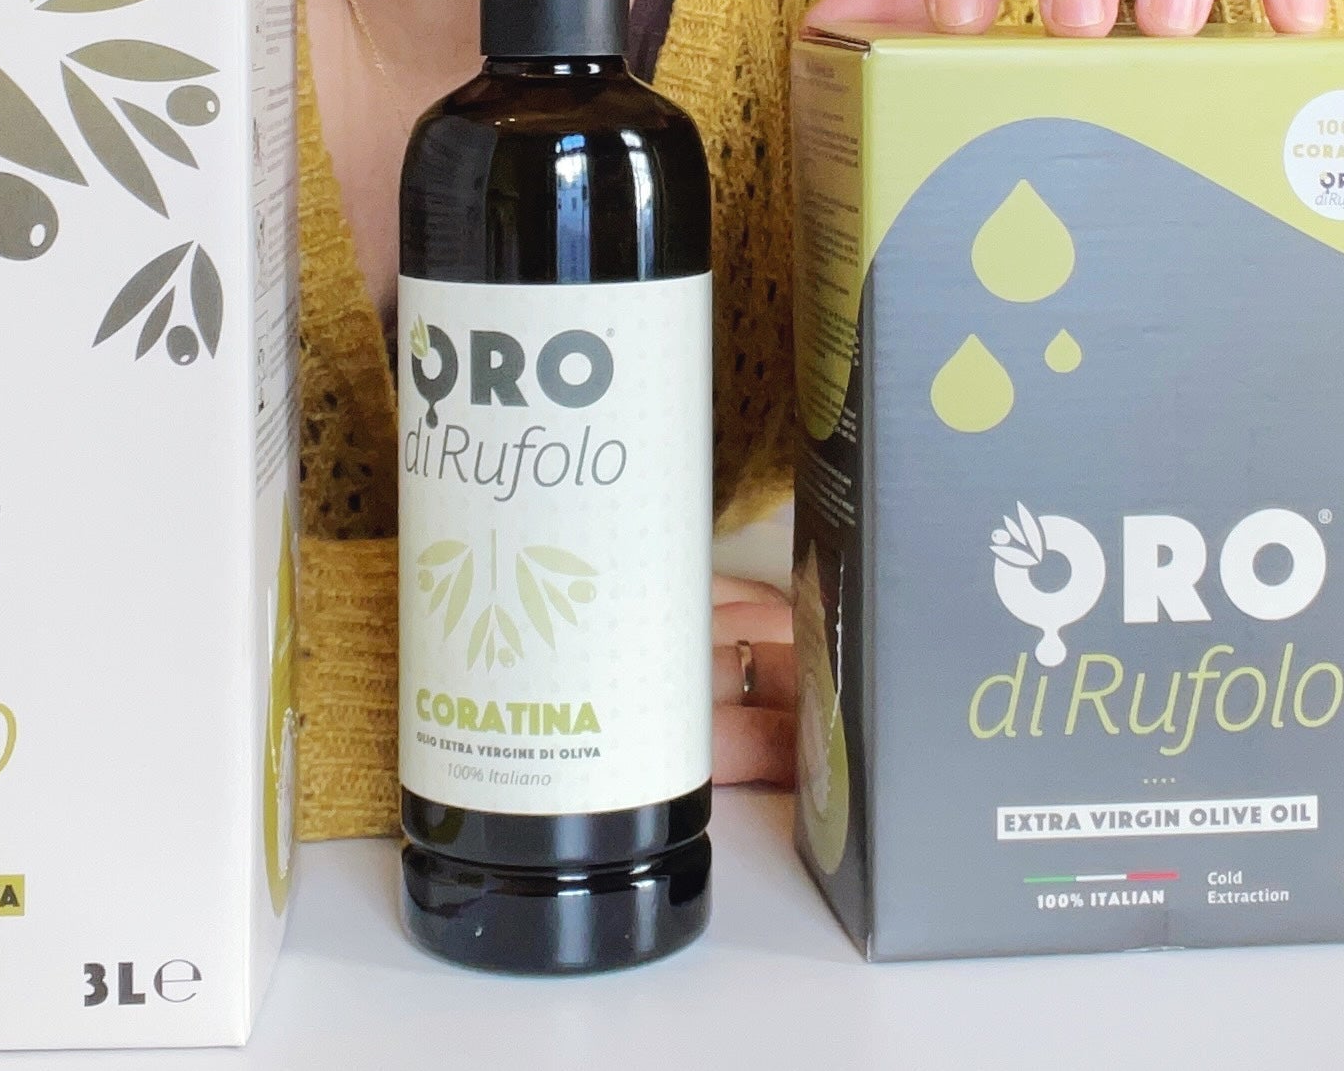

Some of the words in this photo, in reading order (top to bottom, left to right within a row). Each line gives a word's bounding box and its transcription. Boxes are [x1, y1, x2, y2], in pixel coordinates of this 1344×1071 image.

[410, 325, 615, 429] ORO
[405, 417, 431, 478] di
[437, 424, 628, 503] Rufolo
[991, 504, 1327, 667] ORO
[415, 687, 603, 737] CORATINA
[967, 652, 1049, 739] di
[1063, 643, 1344, 757] Rufolo
[416, 731, 438, 748] OLIO
[439, 738, 474, 756] EXTRA
[476, 745, 536, 760] VERGINE
[539, 748, 555, 760] DI
[558, 746, 602, 760] OLIVA
[446, 762, 485, 783] 100%
[487, 768, 552, 787] Italiano
[1003, 811, 1082, 834] EXTRA
[1088, 808, 1181, 831] VIRGIN
[1188, 805, 1263, 827] OLIVE
[1269, 803, 1312, 824] OIL
[1206, 870, 1243, 886] Cold
[1035, 891, 1085, 909] 100%
[1089, 889, 1165, 908] ITALIAN
[1206, 889, 1290, 906] Extraction
